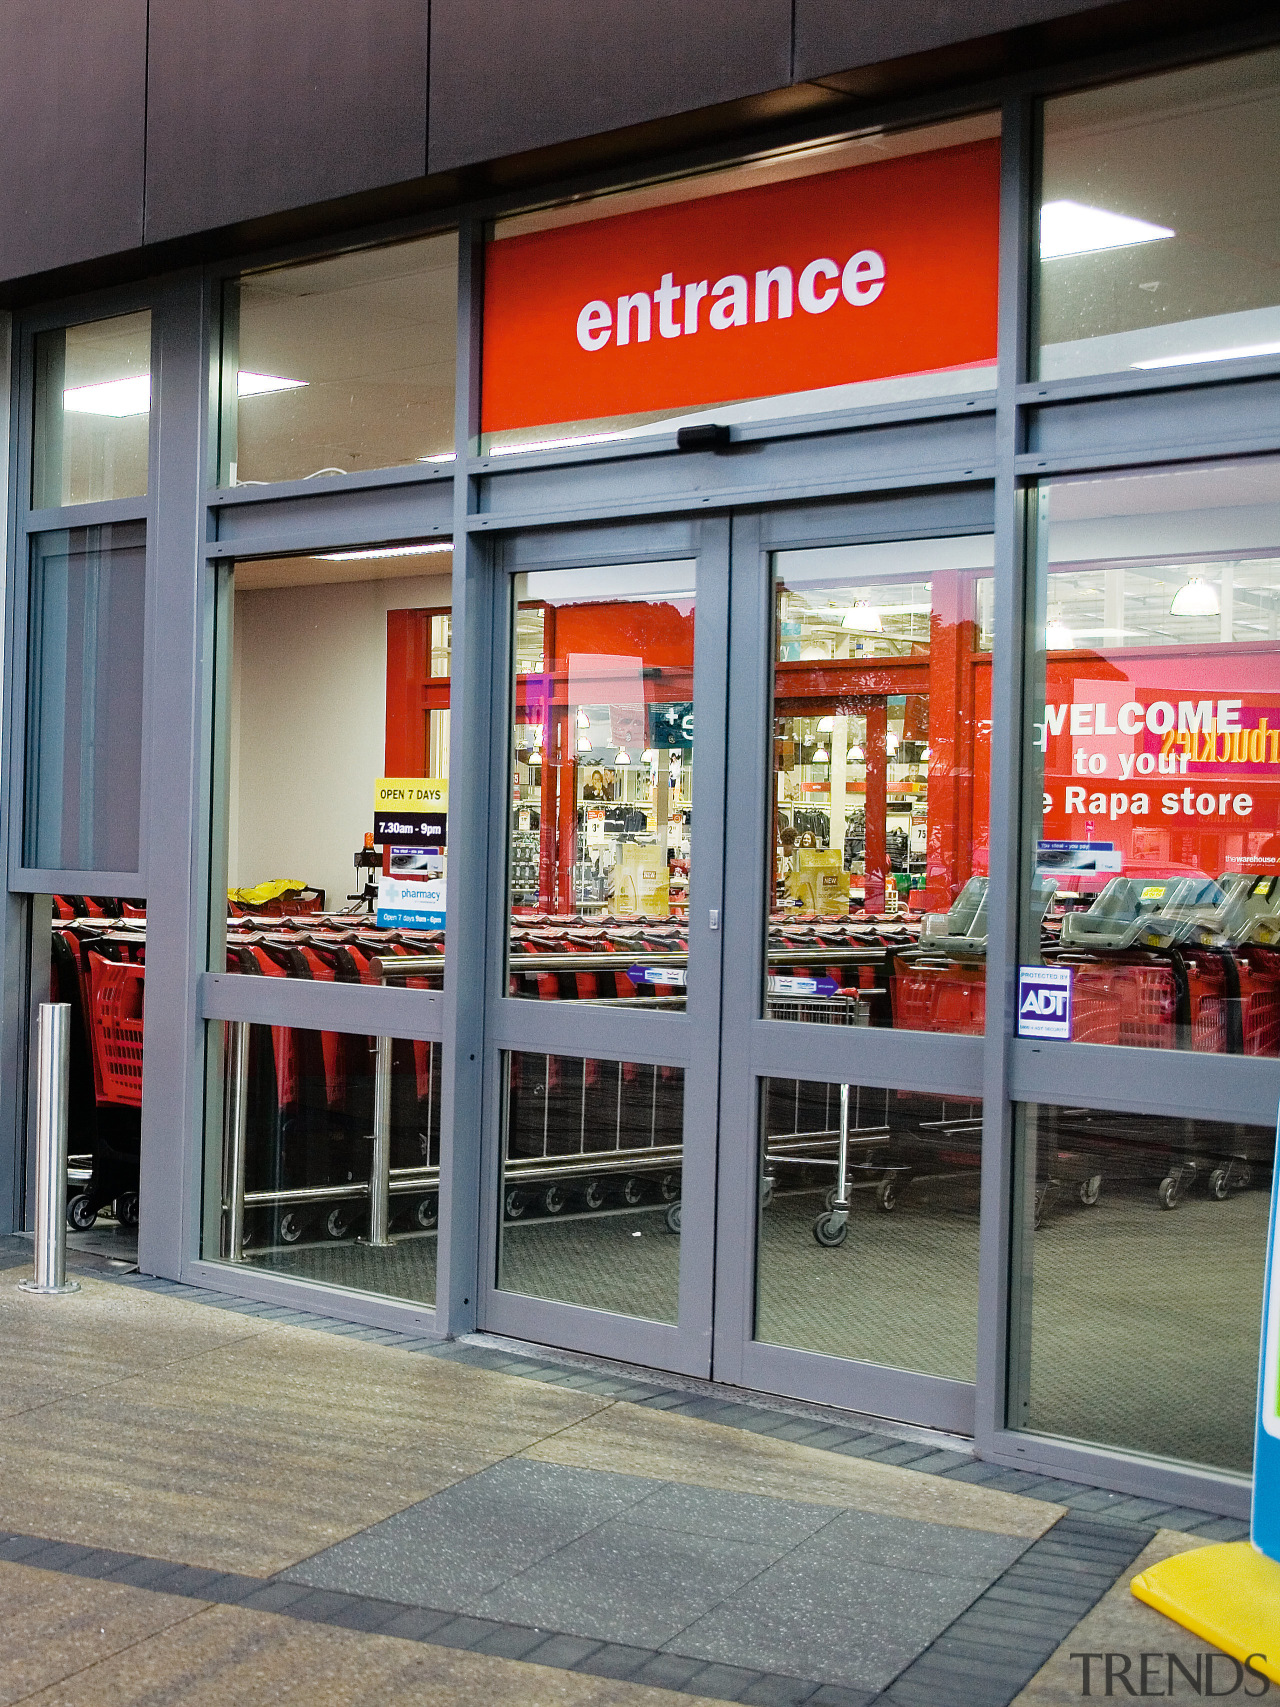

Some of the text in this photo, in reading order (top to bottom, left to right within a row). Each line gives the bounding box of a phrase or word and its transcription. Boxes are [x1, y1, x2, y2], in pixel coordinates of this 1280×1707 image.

[576, 249, 880, 352] entrance
[1044, 700, 1242, 736] WELCOME
[1074, 748, 1192, 781] to your
[380, 789, 441, 800] OPEN 7 DAYS
[1065, 786, 1150, 821] Rapa
[1161, 787, 1253, 816] store
[379, 822, 414, 834] 7.30am
[420, 823, 442, 837] 9pm
[401, 889, 440, 902] pharmacy
[383, 913, 397, 922] Open
[1021, 972, 1058, 980] PROTECTED
[1020, 989, 1068, 1016] ADT
